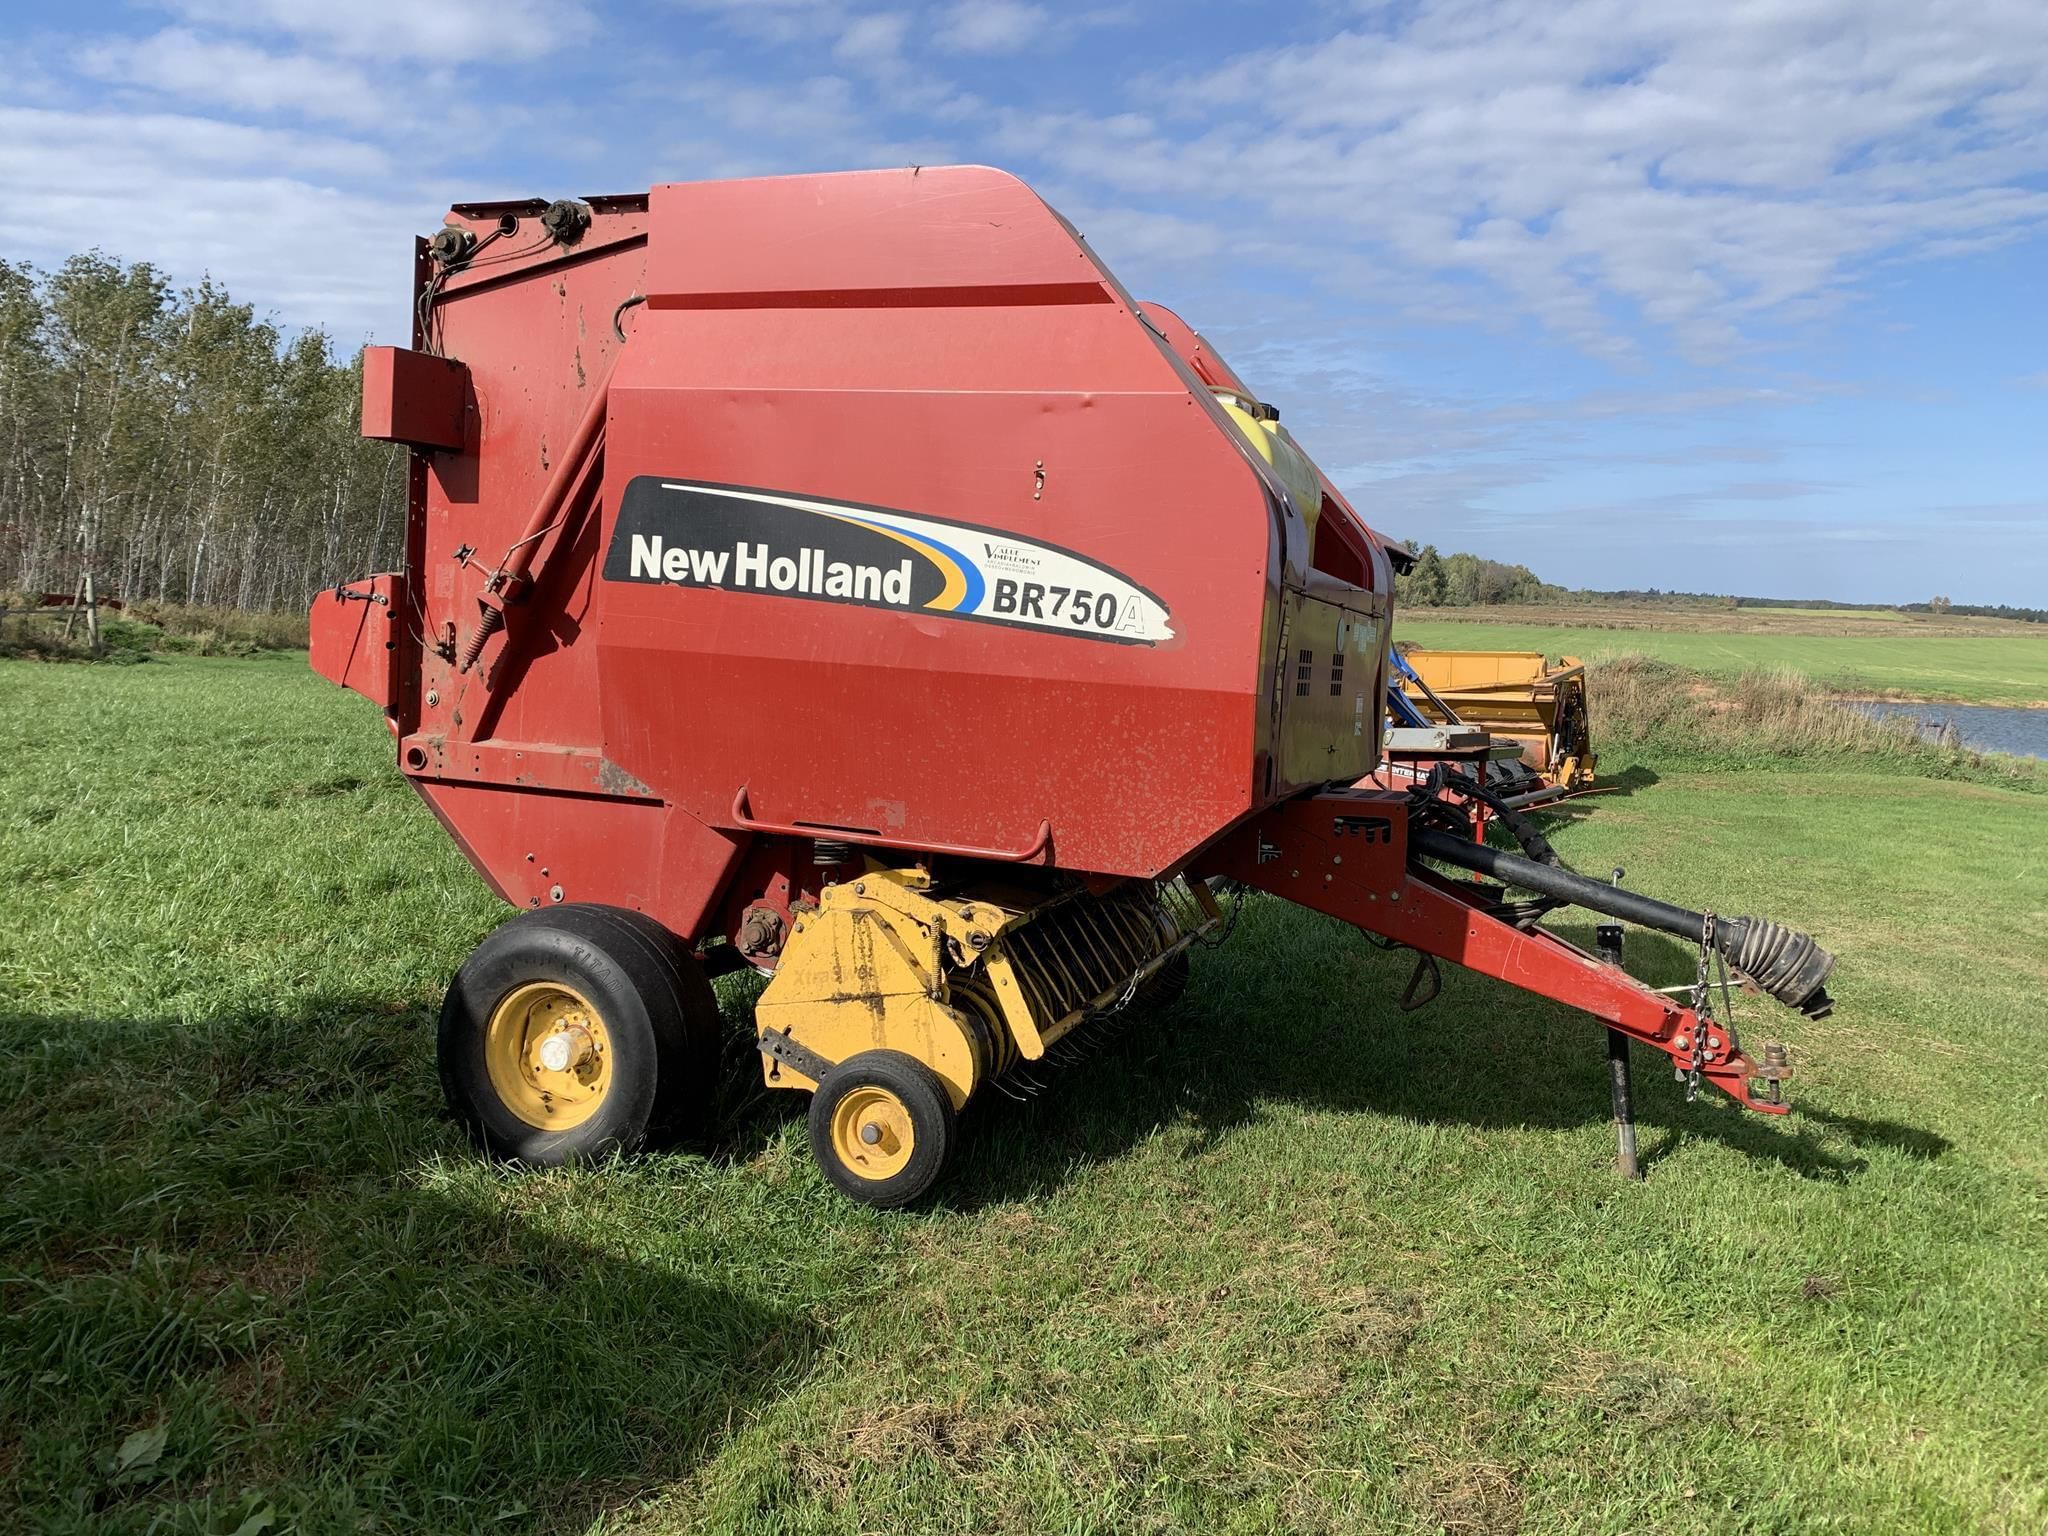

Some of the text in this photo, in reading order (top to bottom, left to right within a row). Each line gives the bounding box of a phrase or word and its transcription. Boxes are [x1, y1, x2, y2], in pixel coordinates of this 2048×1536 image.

[630, 534, 912, 605] New Holland
[994, 578, 1145, 635] BR750A
[574, 946, 623, 992] TITAN
